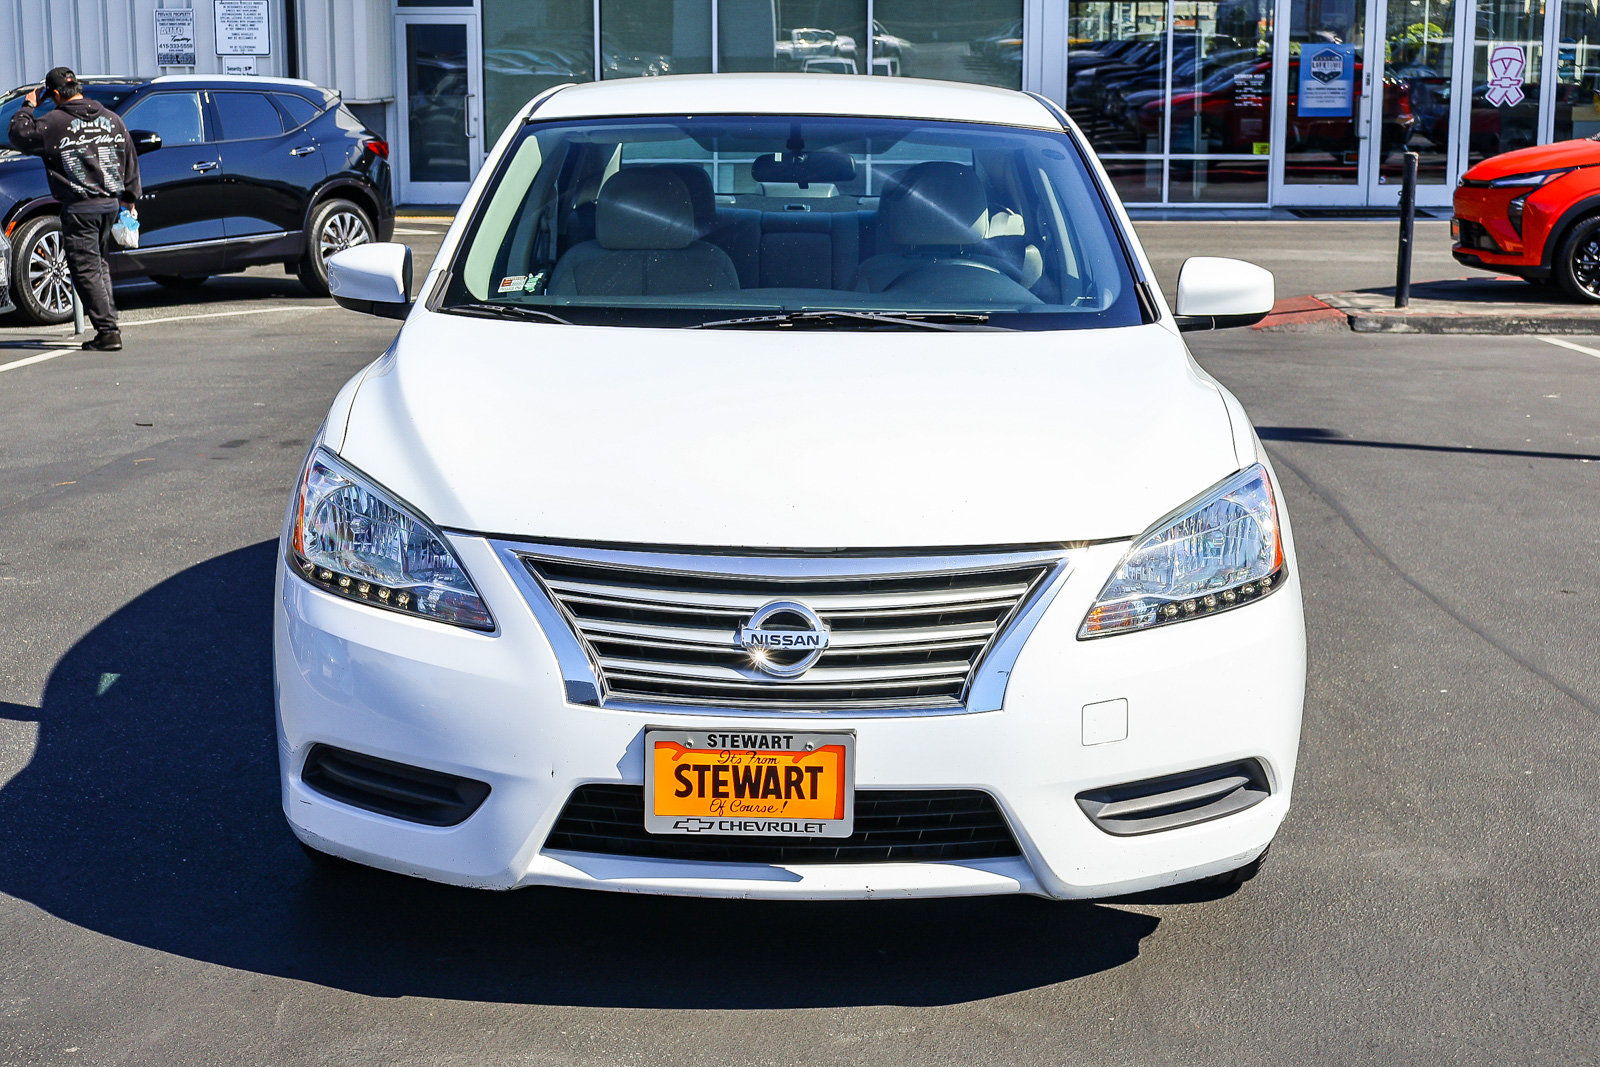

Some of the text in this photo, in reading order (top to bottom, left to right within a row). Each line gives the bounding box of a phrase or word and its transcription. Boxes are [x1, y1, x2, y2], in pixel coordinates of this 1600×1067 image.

[751, 634, 819, 645] NISSAN
[707, 734, 793, 749] STEWART
[717, 750, 780, 764] It's From
[674, 763, 824, 799] STEWART
[709, 798, 726, 816] Of
[718, 821, 826, 833] CHEVROLET
